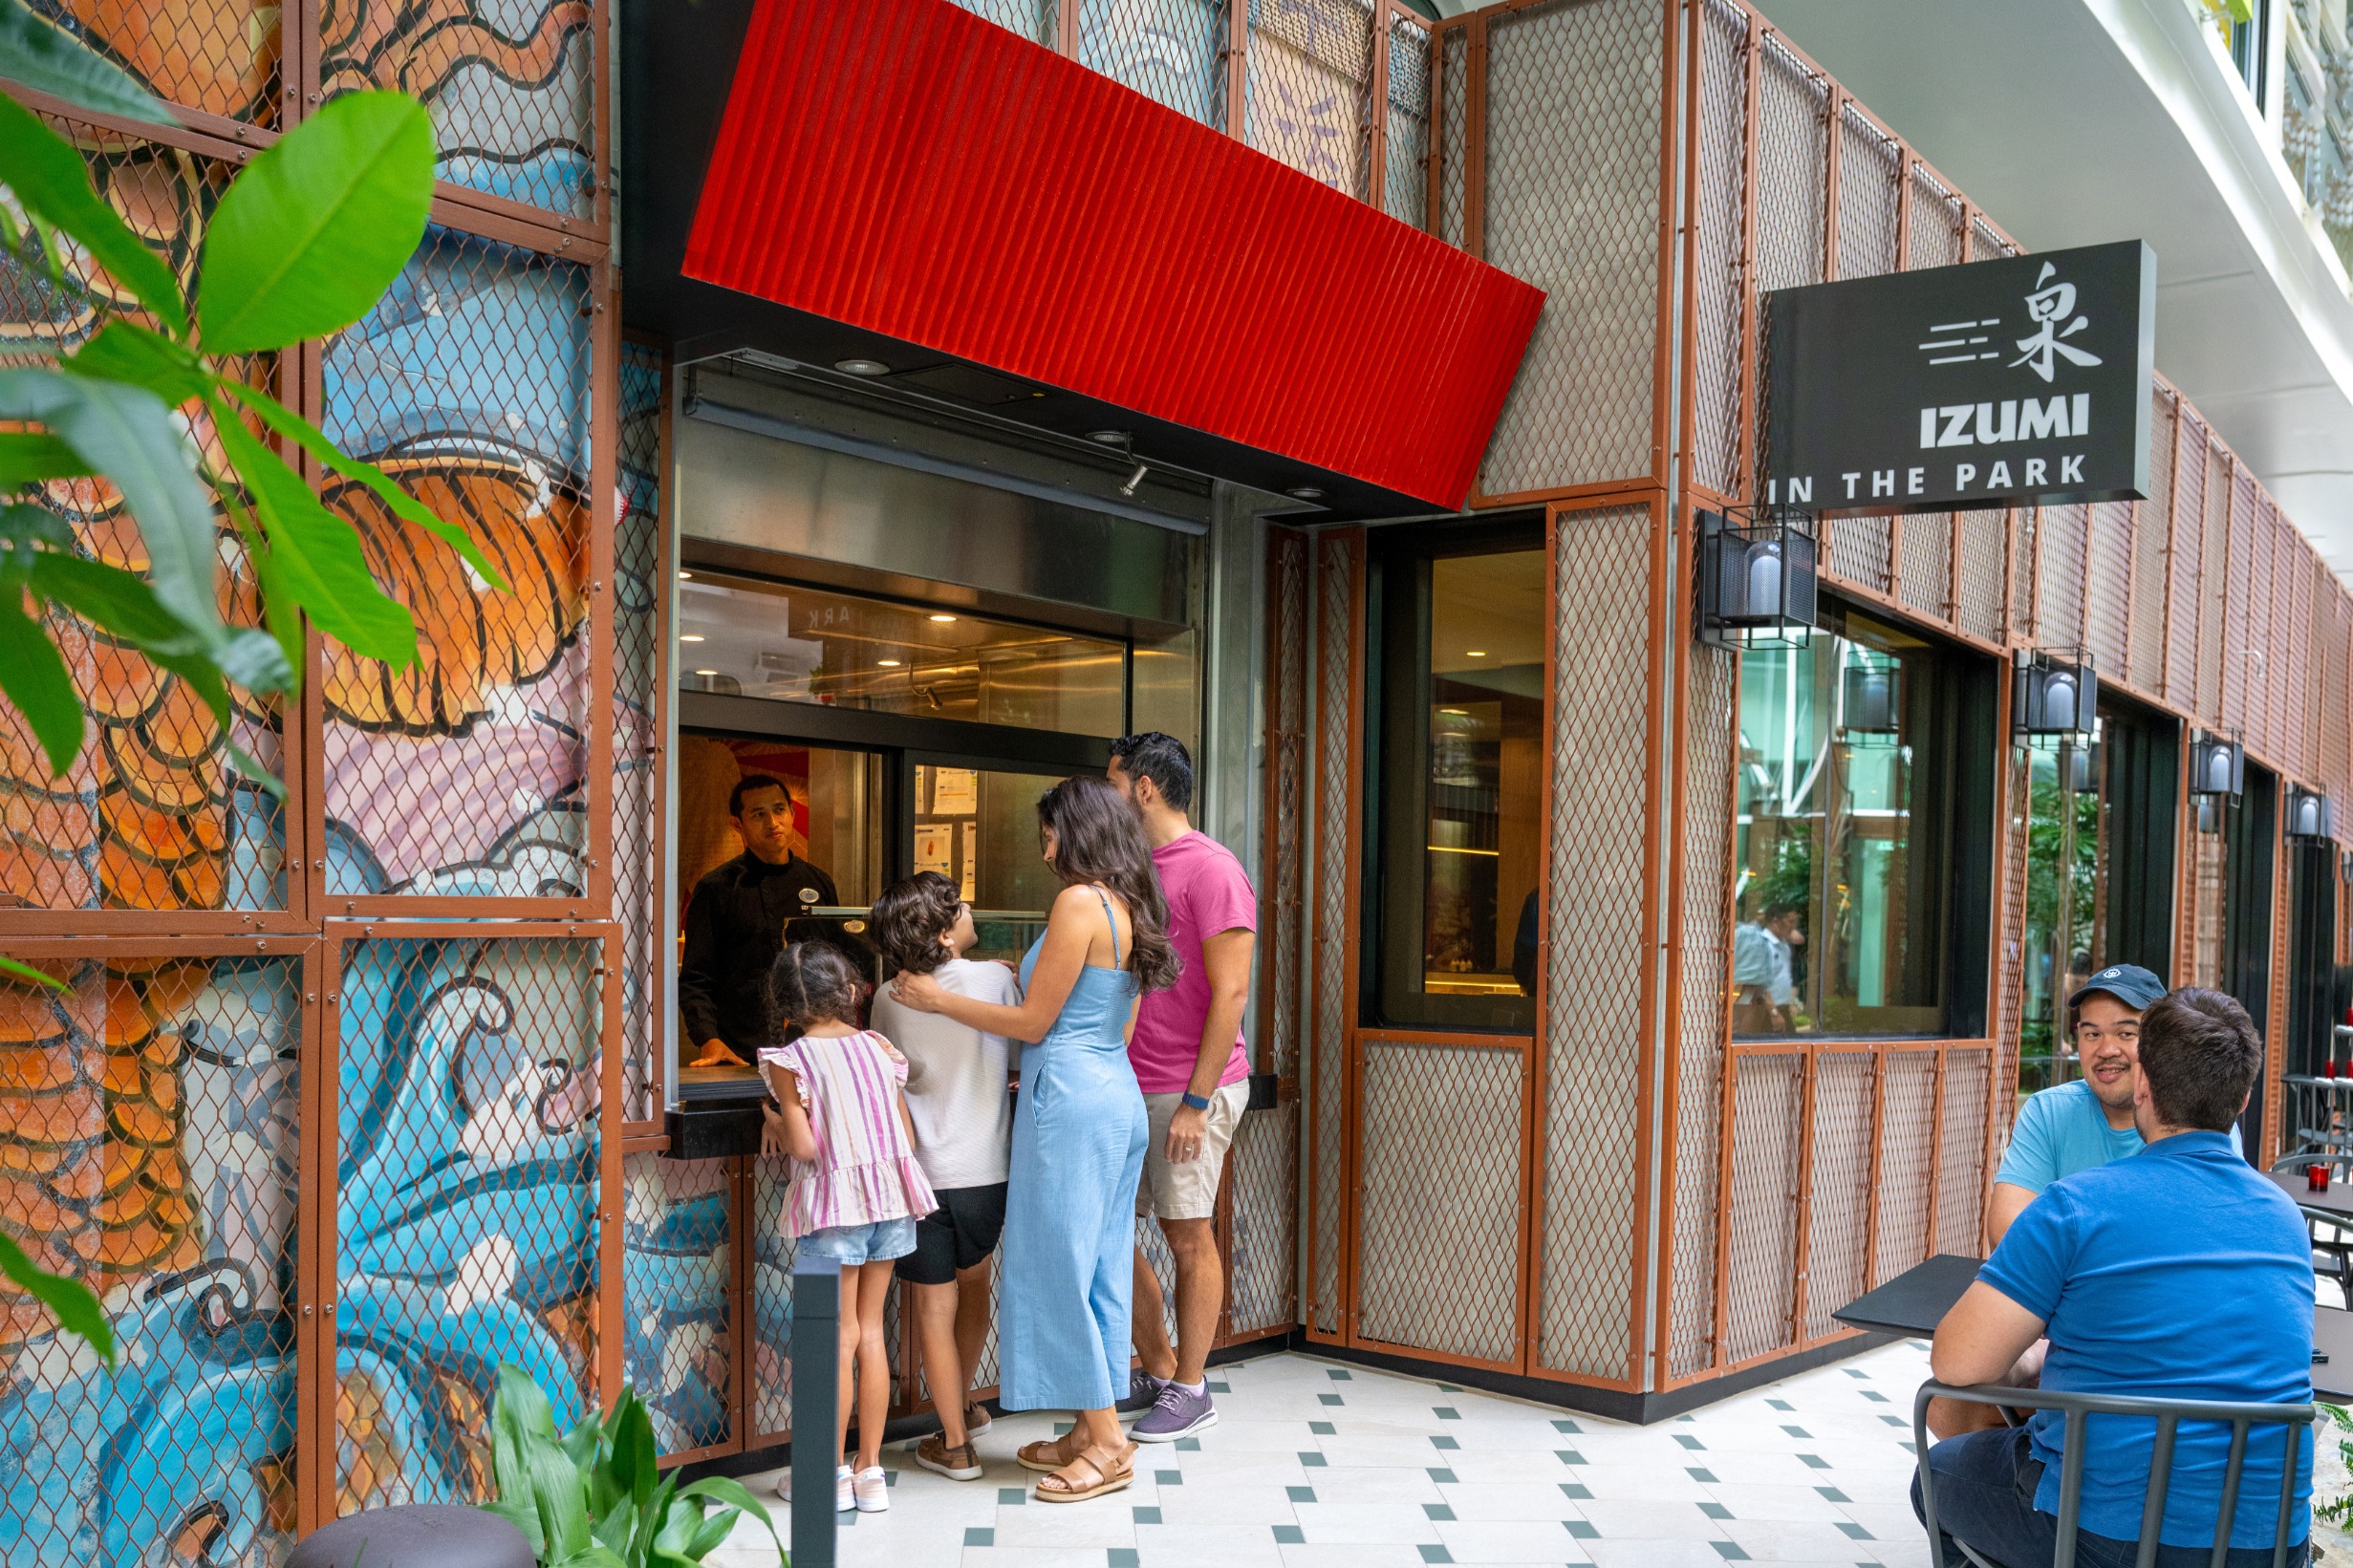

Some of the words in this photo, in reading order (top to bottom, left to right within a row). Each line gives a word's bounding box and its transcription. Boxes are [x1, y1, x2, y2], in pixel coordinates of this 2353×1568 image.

[2008, 261, 2103, 383] 泉
[1919, 393, 2090, 449] IZUMI
[1768, 476, 1812, 505] IN
[1842, 466, 1925, 500] THE
[1955, 454, 2085, 491] PARK
